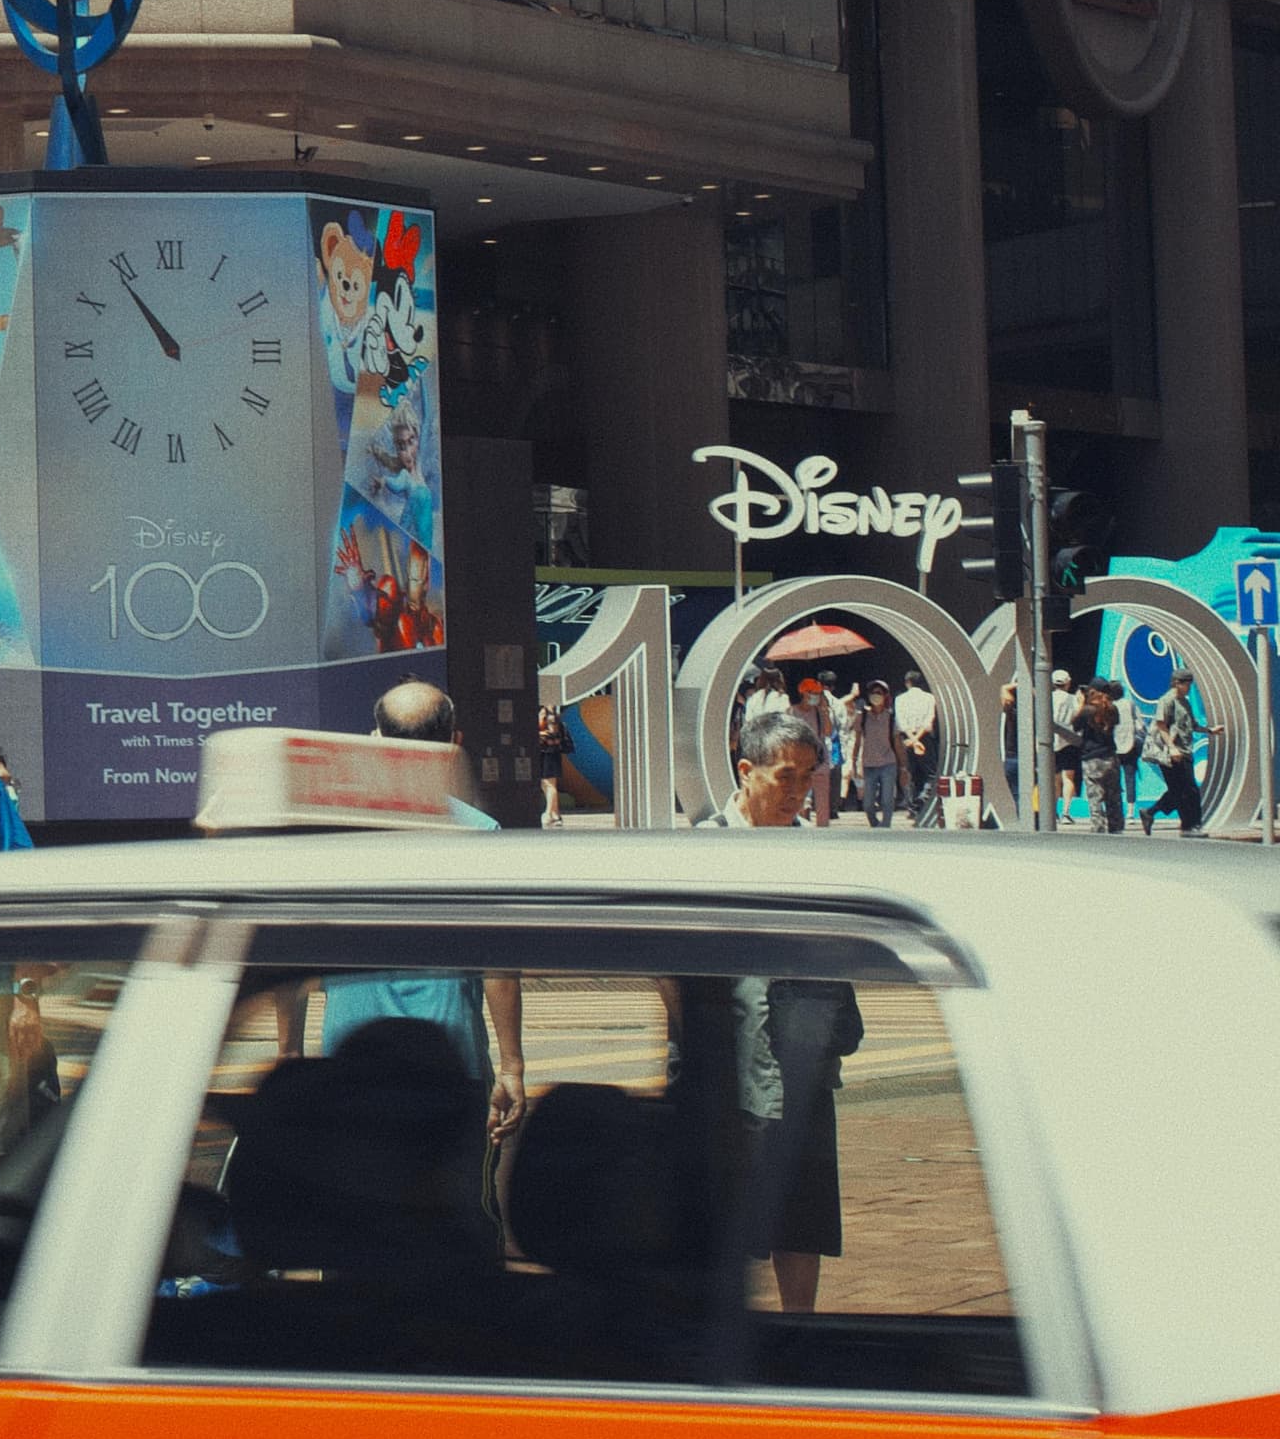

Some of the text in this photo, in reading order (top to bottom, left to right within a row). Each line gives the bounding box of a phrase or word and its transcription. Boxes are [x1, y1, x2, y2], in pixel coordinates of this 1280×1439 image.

[108, 252, 138, 281] XI
[156, 240, 184, 269] XII
[210, 254, 228, 282] I
[76, 291, 106, 316] X
[238, 290, 269, 317] II
[65, 340, 93, 359] IX
[252, 338, 281, 364] III
[72, 378, 112, 423] VIII
[241, 386, 270, 416] IV
[110, 417, 143, 455] VII
[167, 433, 186, 463] VI
[213, 422, 234, 451] V
[90, 561, 270, 641] 100
[86, 701, 278, 728] Travel Together
[121, 735, 151, 747] with
[154, 735, 194, 747] Times
[103, 768, 198, 784] From Now
